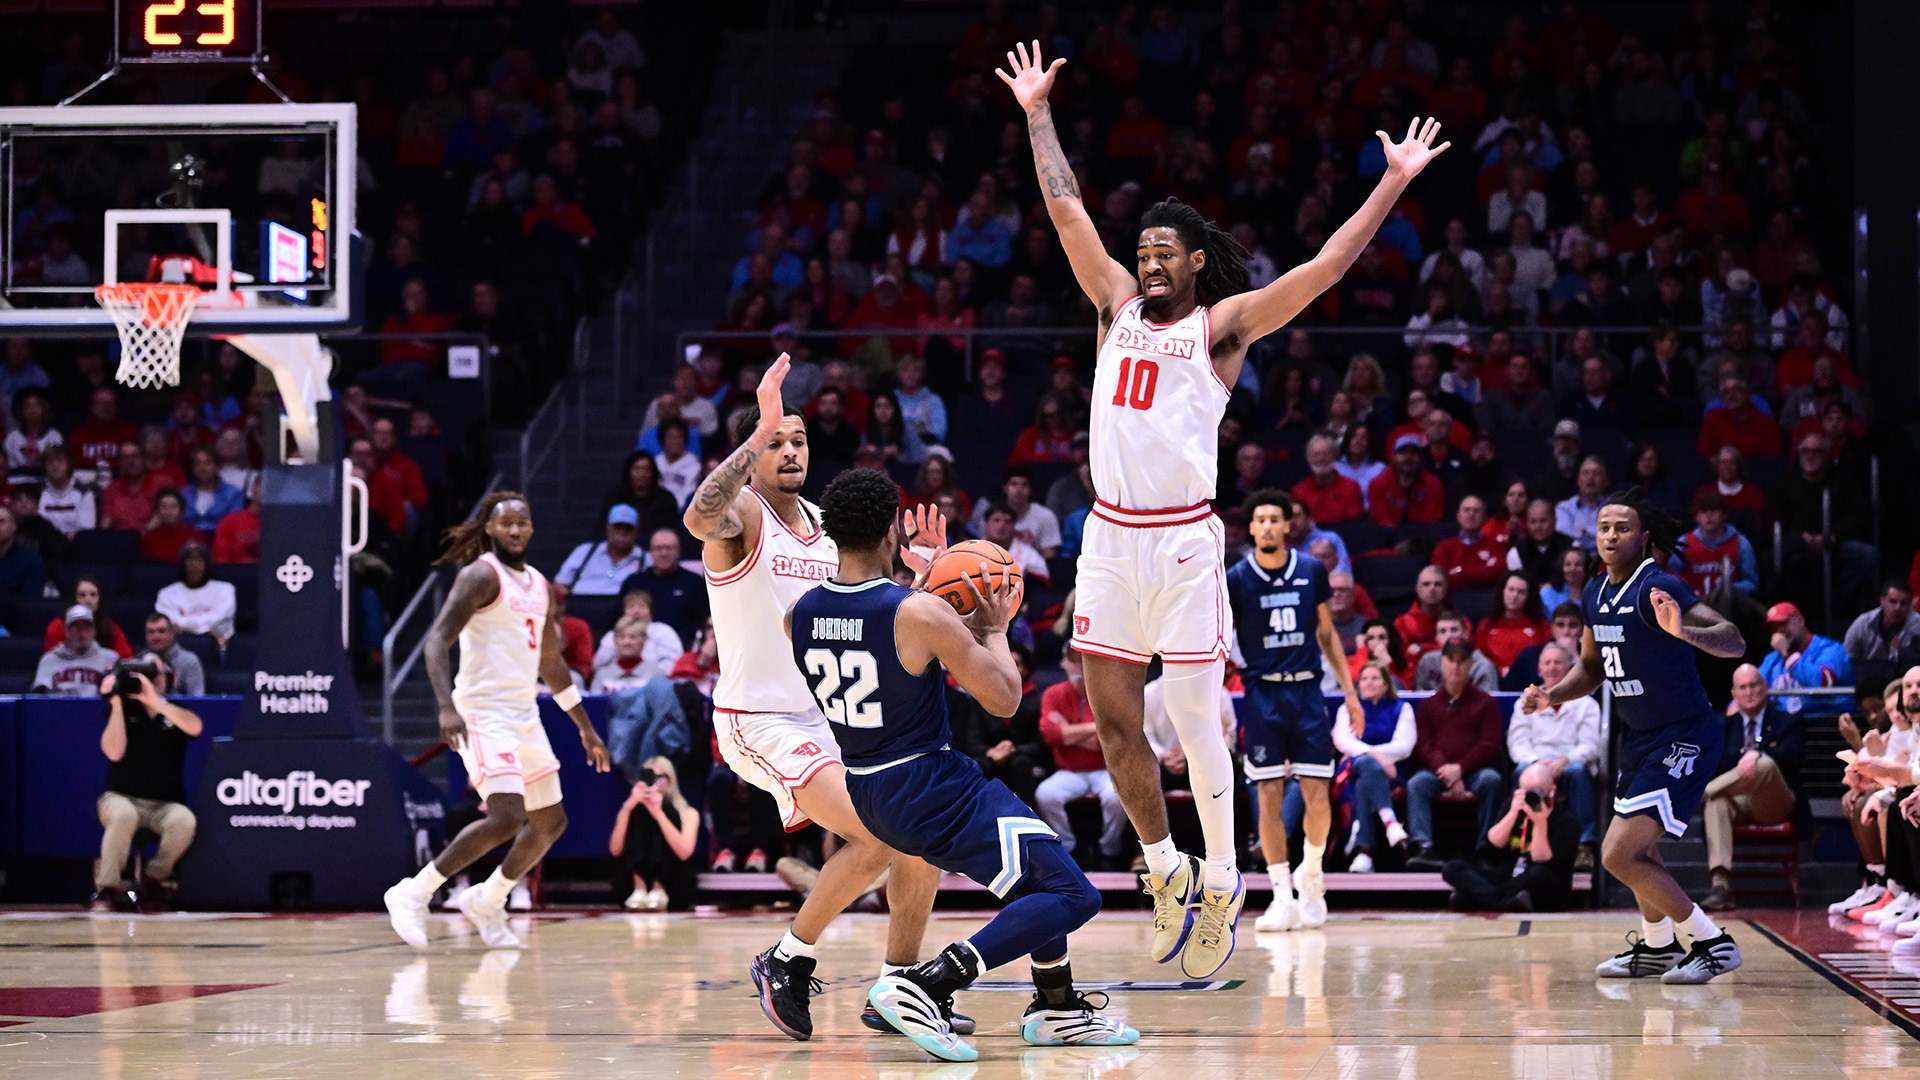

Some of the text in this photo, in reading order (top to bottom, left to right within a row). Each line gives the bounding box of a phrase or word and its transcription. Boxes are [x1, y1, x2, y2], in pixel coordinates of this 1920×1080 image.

[144, 0, 235, 45] 23
[1112, 356, 1160, 411] 10
[525, 618, 537, 650] 3
[812, 617, 864, 641] JOHNSON
[1269, 607, 1297, 632] 40
[1601, 646, 1626, 677] 21
[254, 670, 335, 692] Premier
[803, 647, 884, 729] 22
[260, 692, 329, 714] Health
[216, 770, 372, 814] altafiber
[229, 814, 357, 831] connecting dayton
